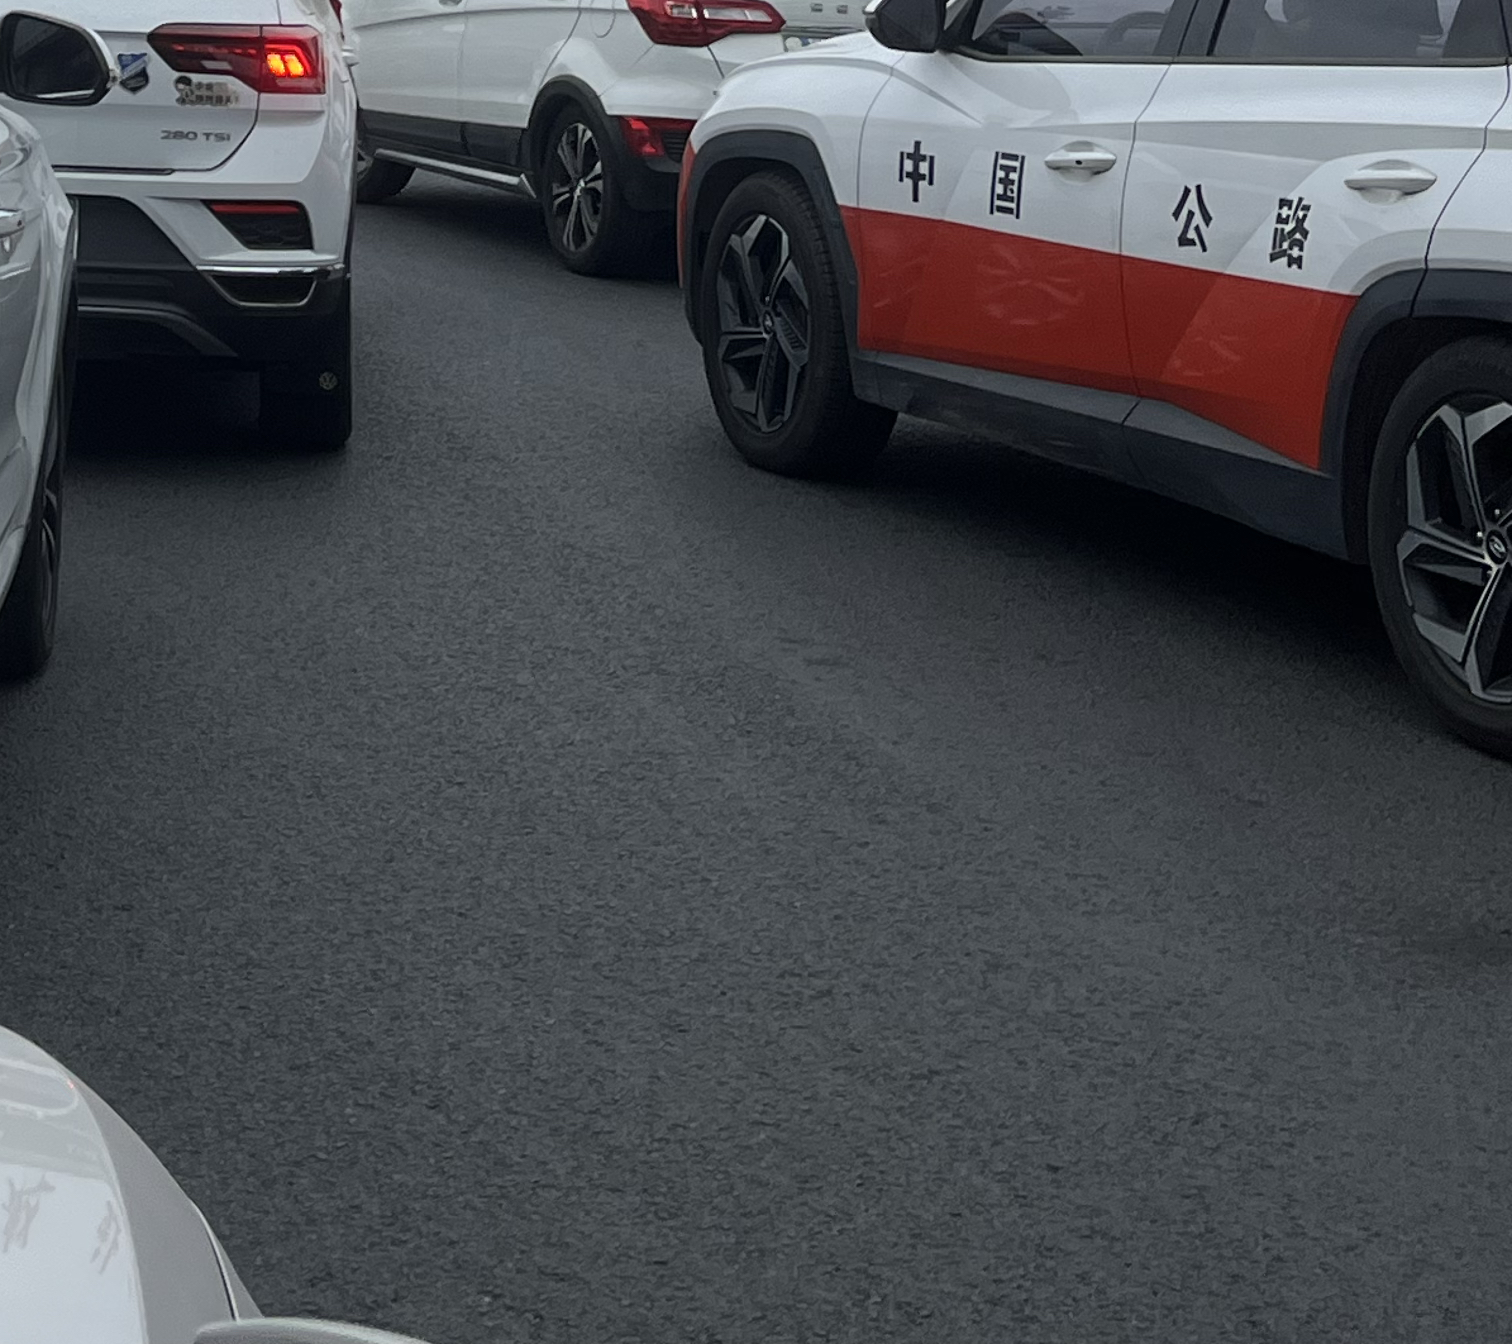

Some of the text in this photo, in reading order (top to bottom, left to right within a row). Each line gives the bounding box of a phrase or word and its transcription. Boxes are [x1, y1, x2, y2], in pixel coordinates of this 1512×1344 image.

[160, 130, 231, 142] 280 TSI
[899, 140, 1311, 270] 中国公路
